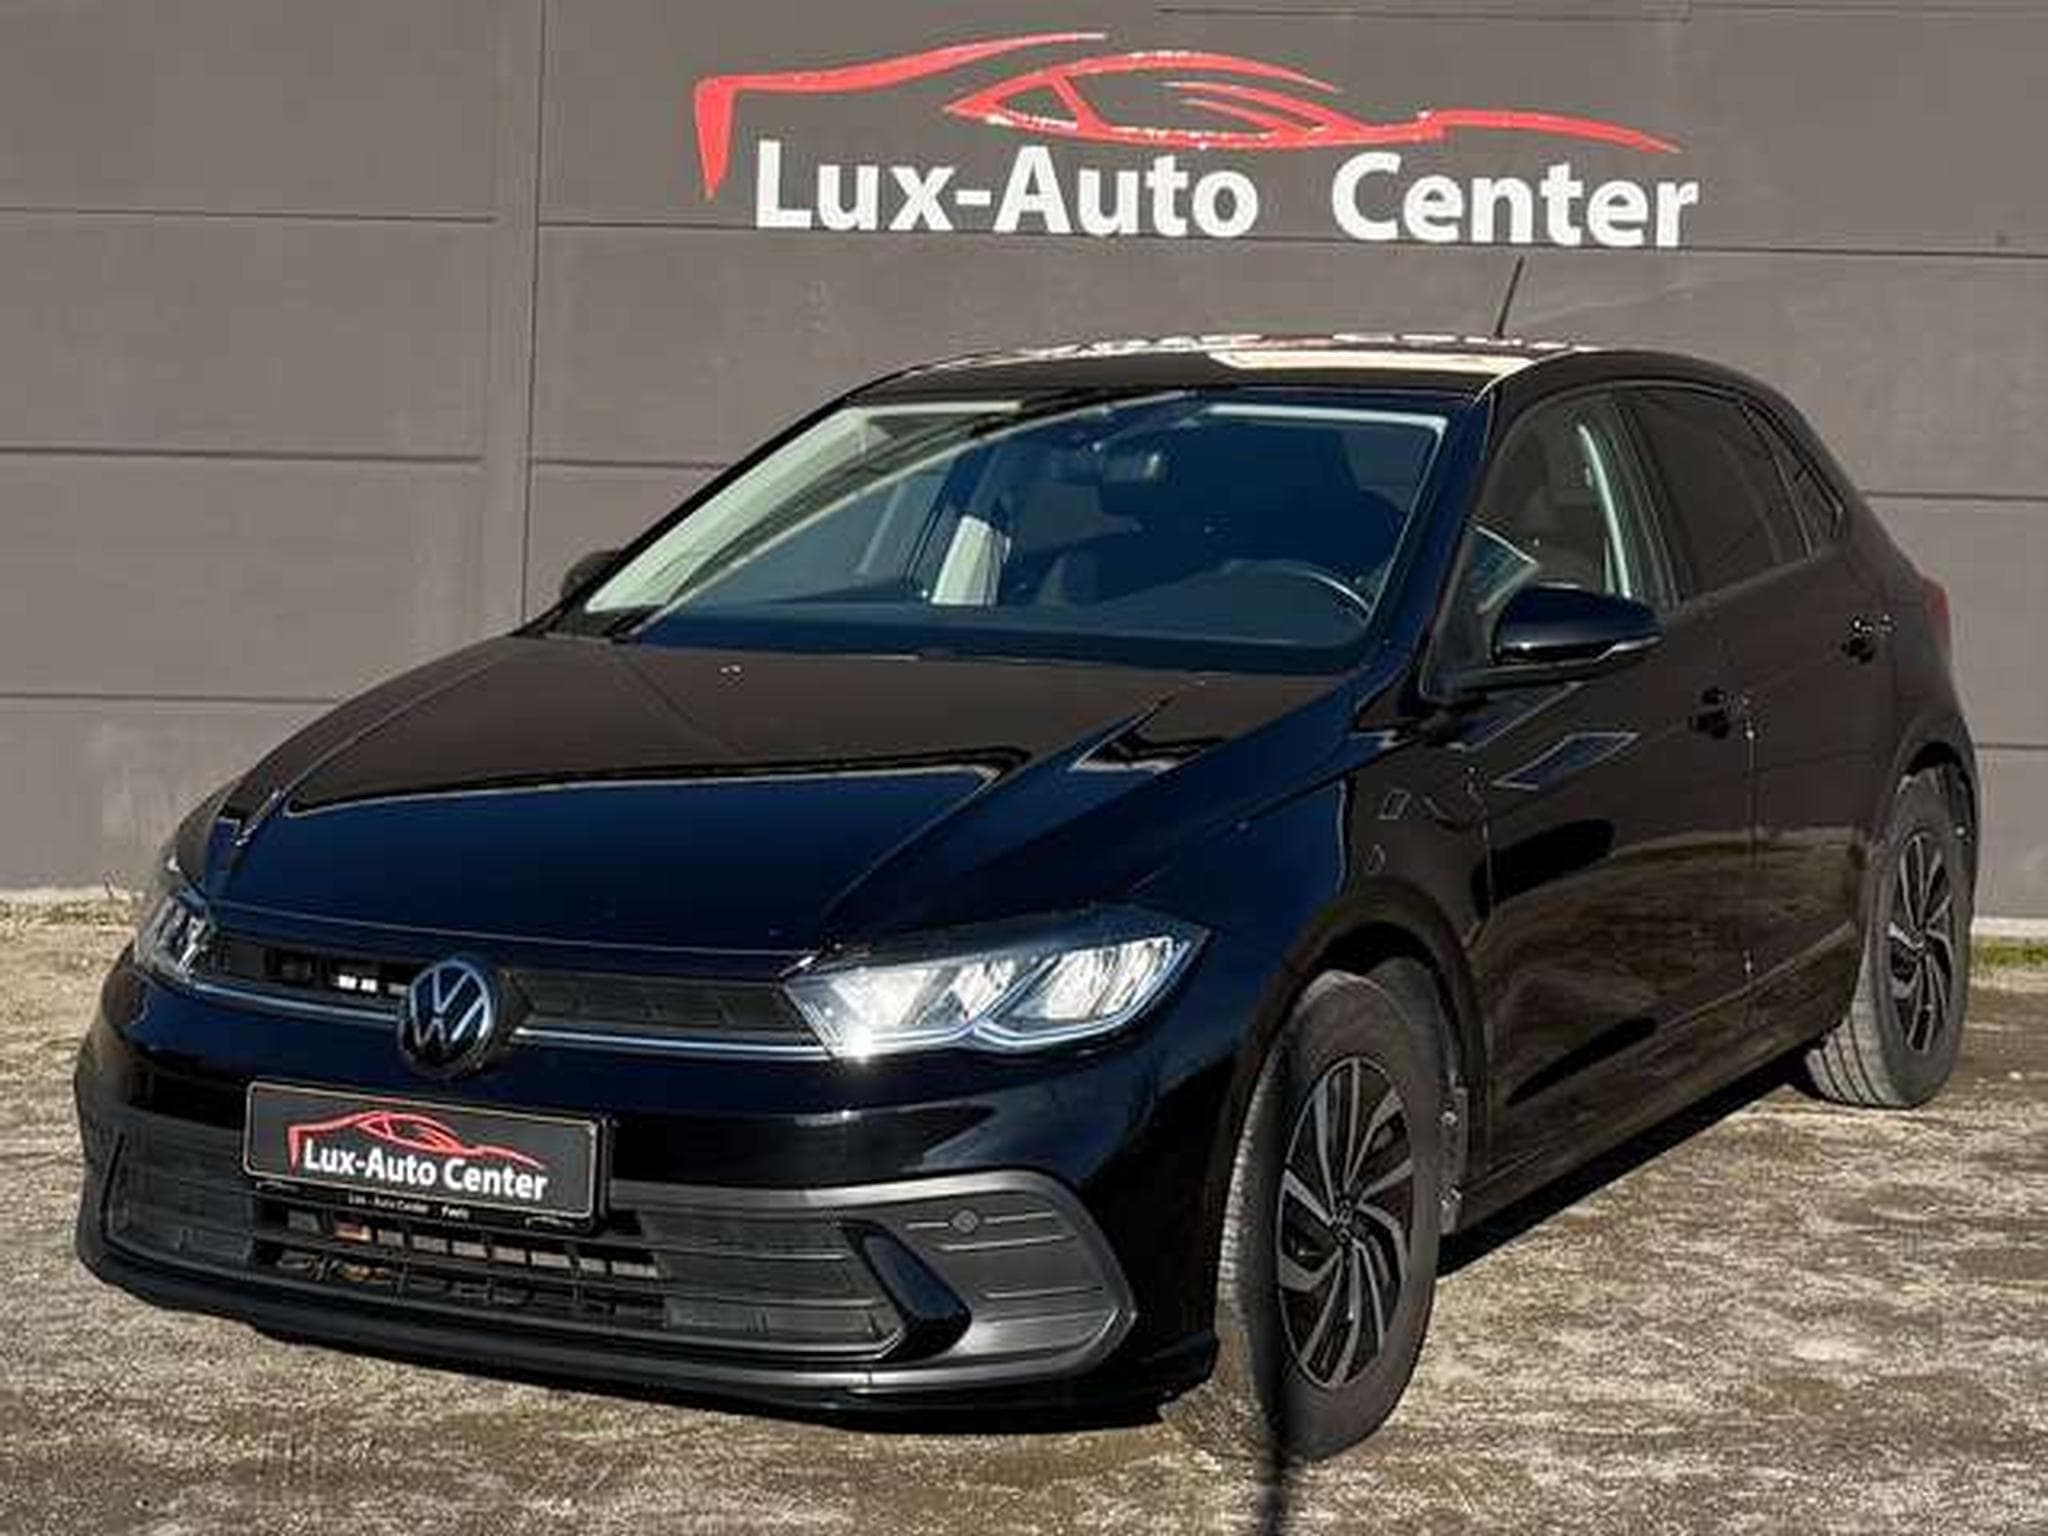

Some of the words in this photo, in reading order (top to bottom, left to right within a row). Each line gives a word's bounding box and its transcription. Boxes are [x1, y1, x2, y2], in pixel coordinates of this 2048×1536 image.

[757, 140, 1259, 238] Lux-Auto
[1330, 152, 1698, 248] Center
[304, 1138, 436, 1186] Lux-Auto
[443, 1160, 549, 1201] Center
